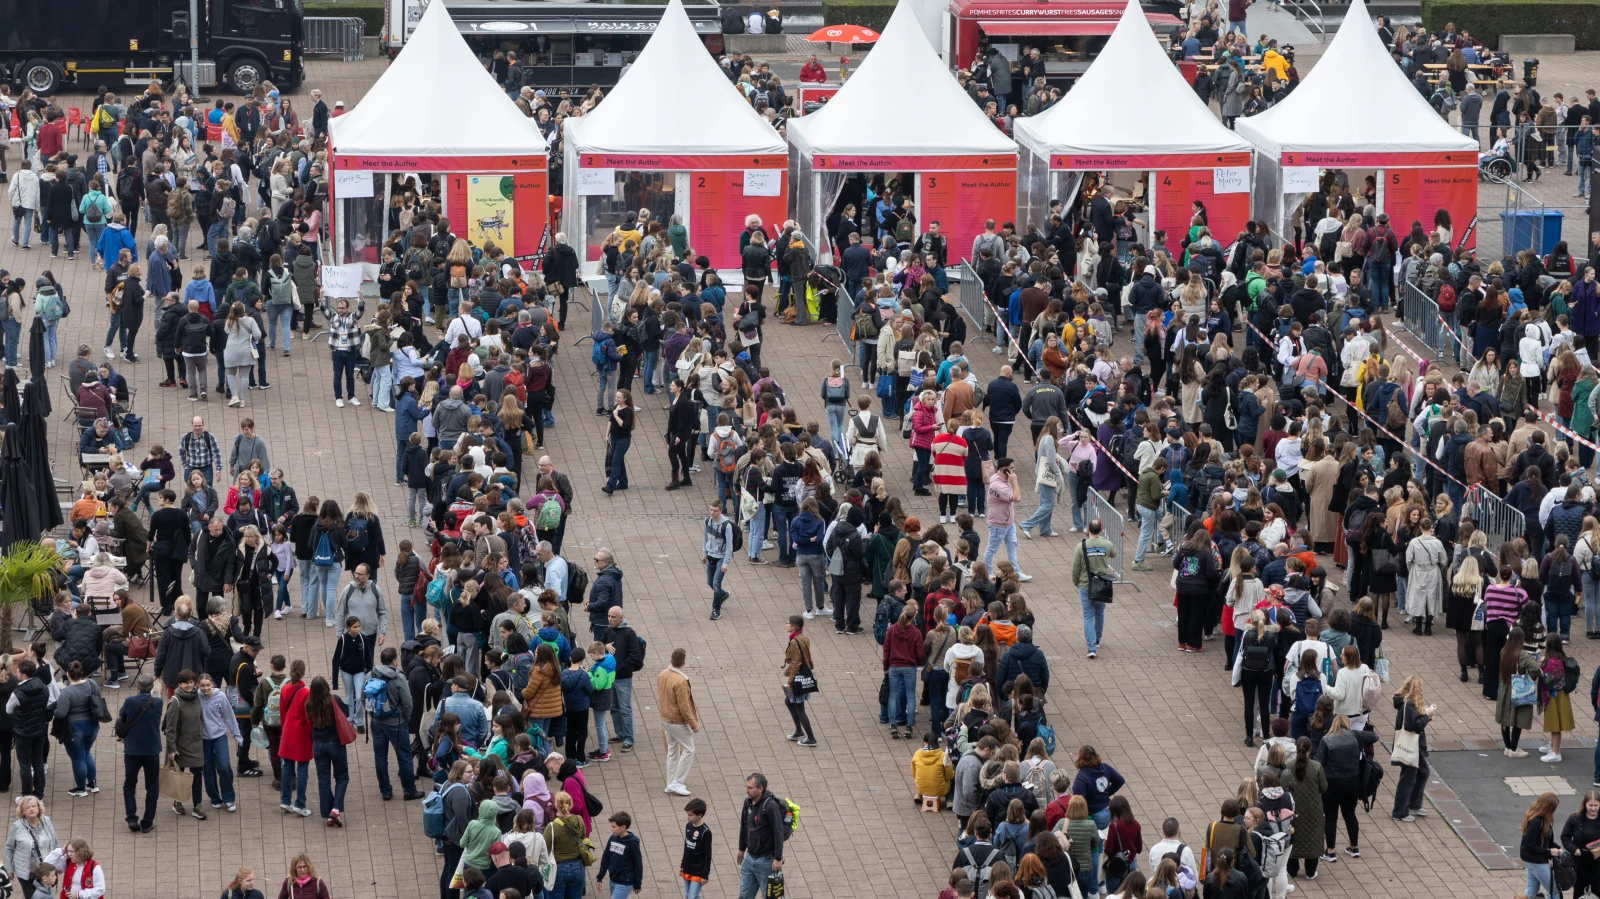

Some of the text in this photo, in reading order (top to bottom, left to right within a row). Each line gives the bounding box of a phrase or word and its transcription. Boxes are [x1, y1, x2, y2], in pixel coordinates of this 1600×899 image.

[344, 159, 348, 167] 1
[587, 157, 593, 165] 2
[820, 158, 826, 166] 3
[1056, 158, 1063, 166] 4
[697, 177, 706, 188] 2
[928, 177, 936, 188] 3
[1163, 176, 1172, 187] 4
[1392, 174, 1400, 184] 5
[455, 179, 461, 190] 1
